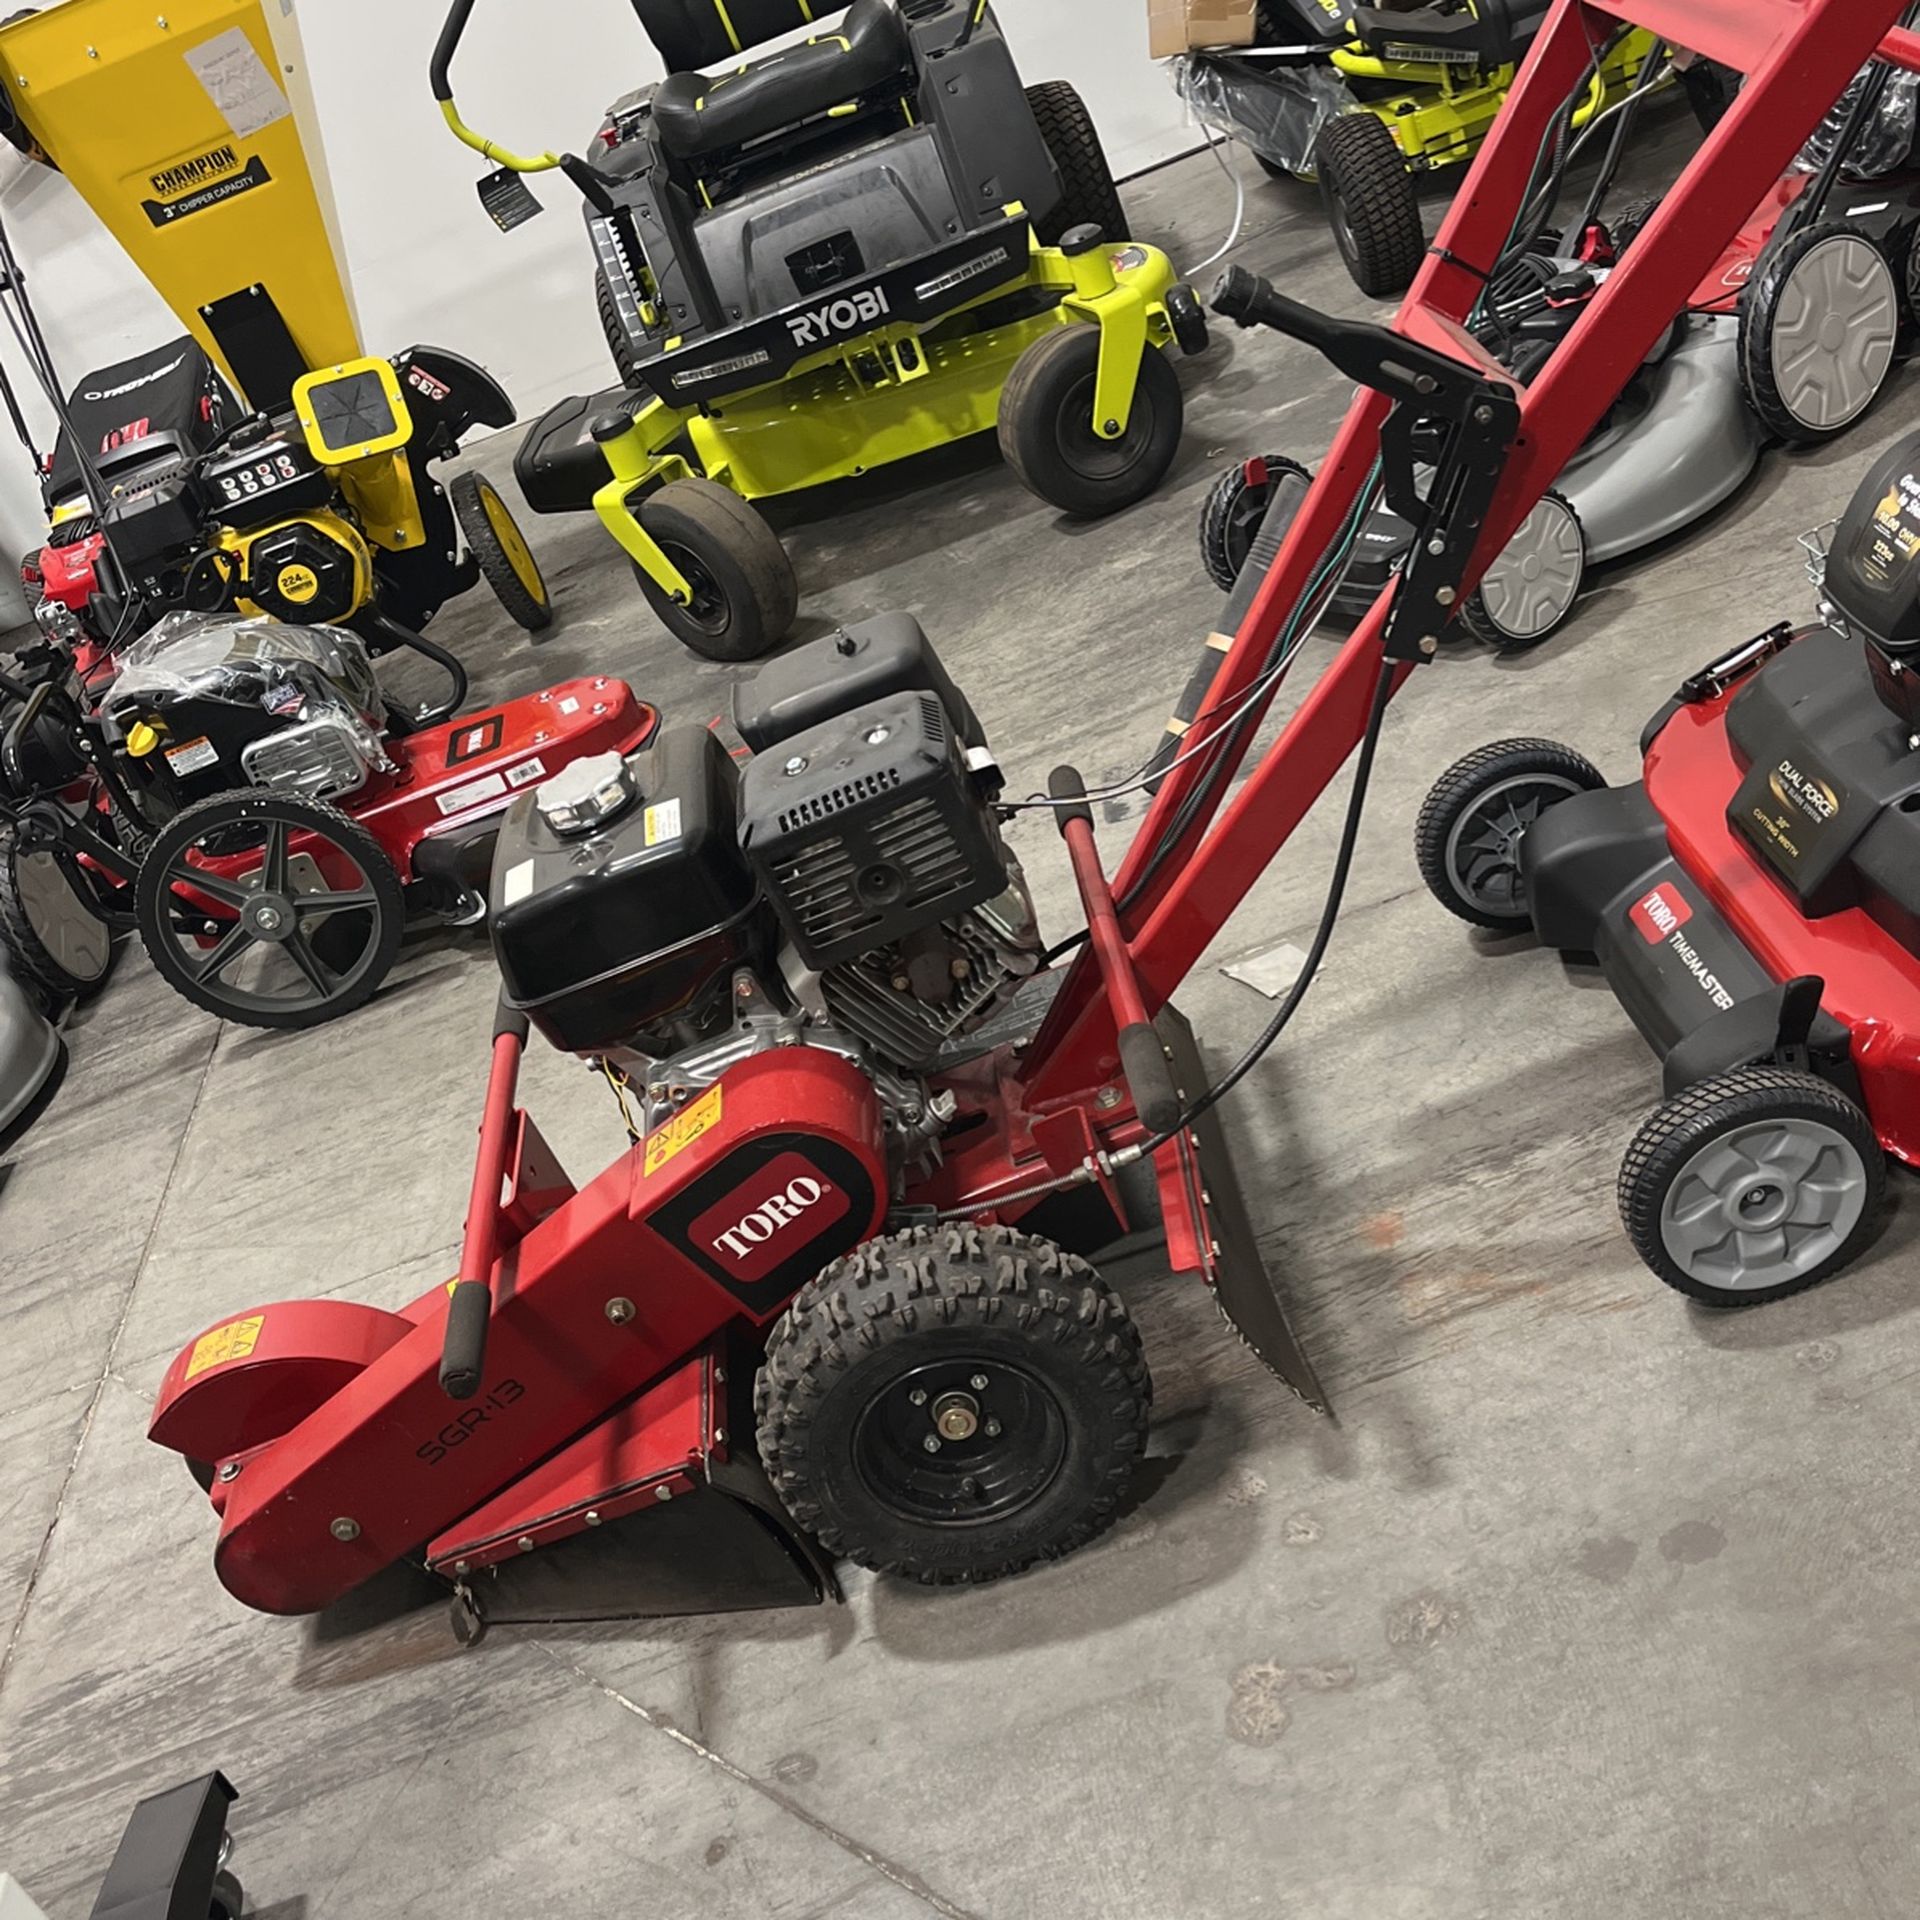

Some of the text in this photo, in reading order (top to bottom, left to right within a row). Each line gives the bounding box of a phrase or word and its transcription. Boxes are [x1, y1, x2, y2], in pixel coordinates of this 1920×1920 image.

[151, 146, 236, 192] CHAMPION
[179, 192, 215, 212] CHIPPER
[213, 175, 255, 198] CAPACITY
[785, 285, 890, 347] RYOBI
[1778, 759, 1835, 818] DUAL FORCE
[1753, 807, 1799, 858] CUTTING WIDTH
[1643, 891, 1678, 934] TORO
[1668, 930, 1735, 1011] TIMEMASTER
[712, 1176, 821, 1260] TORO
